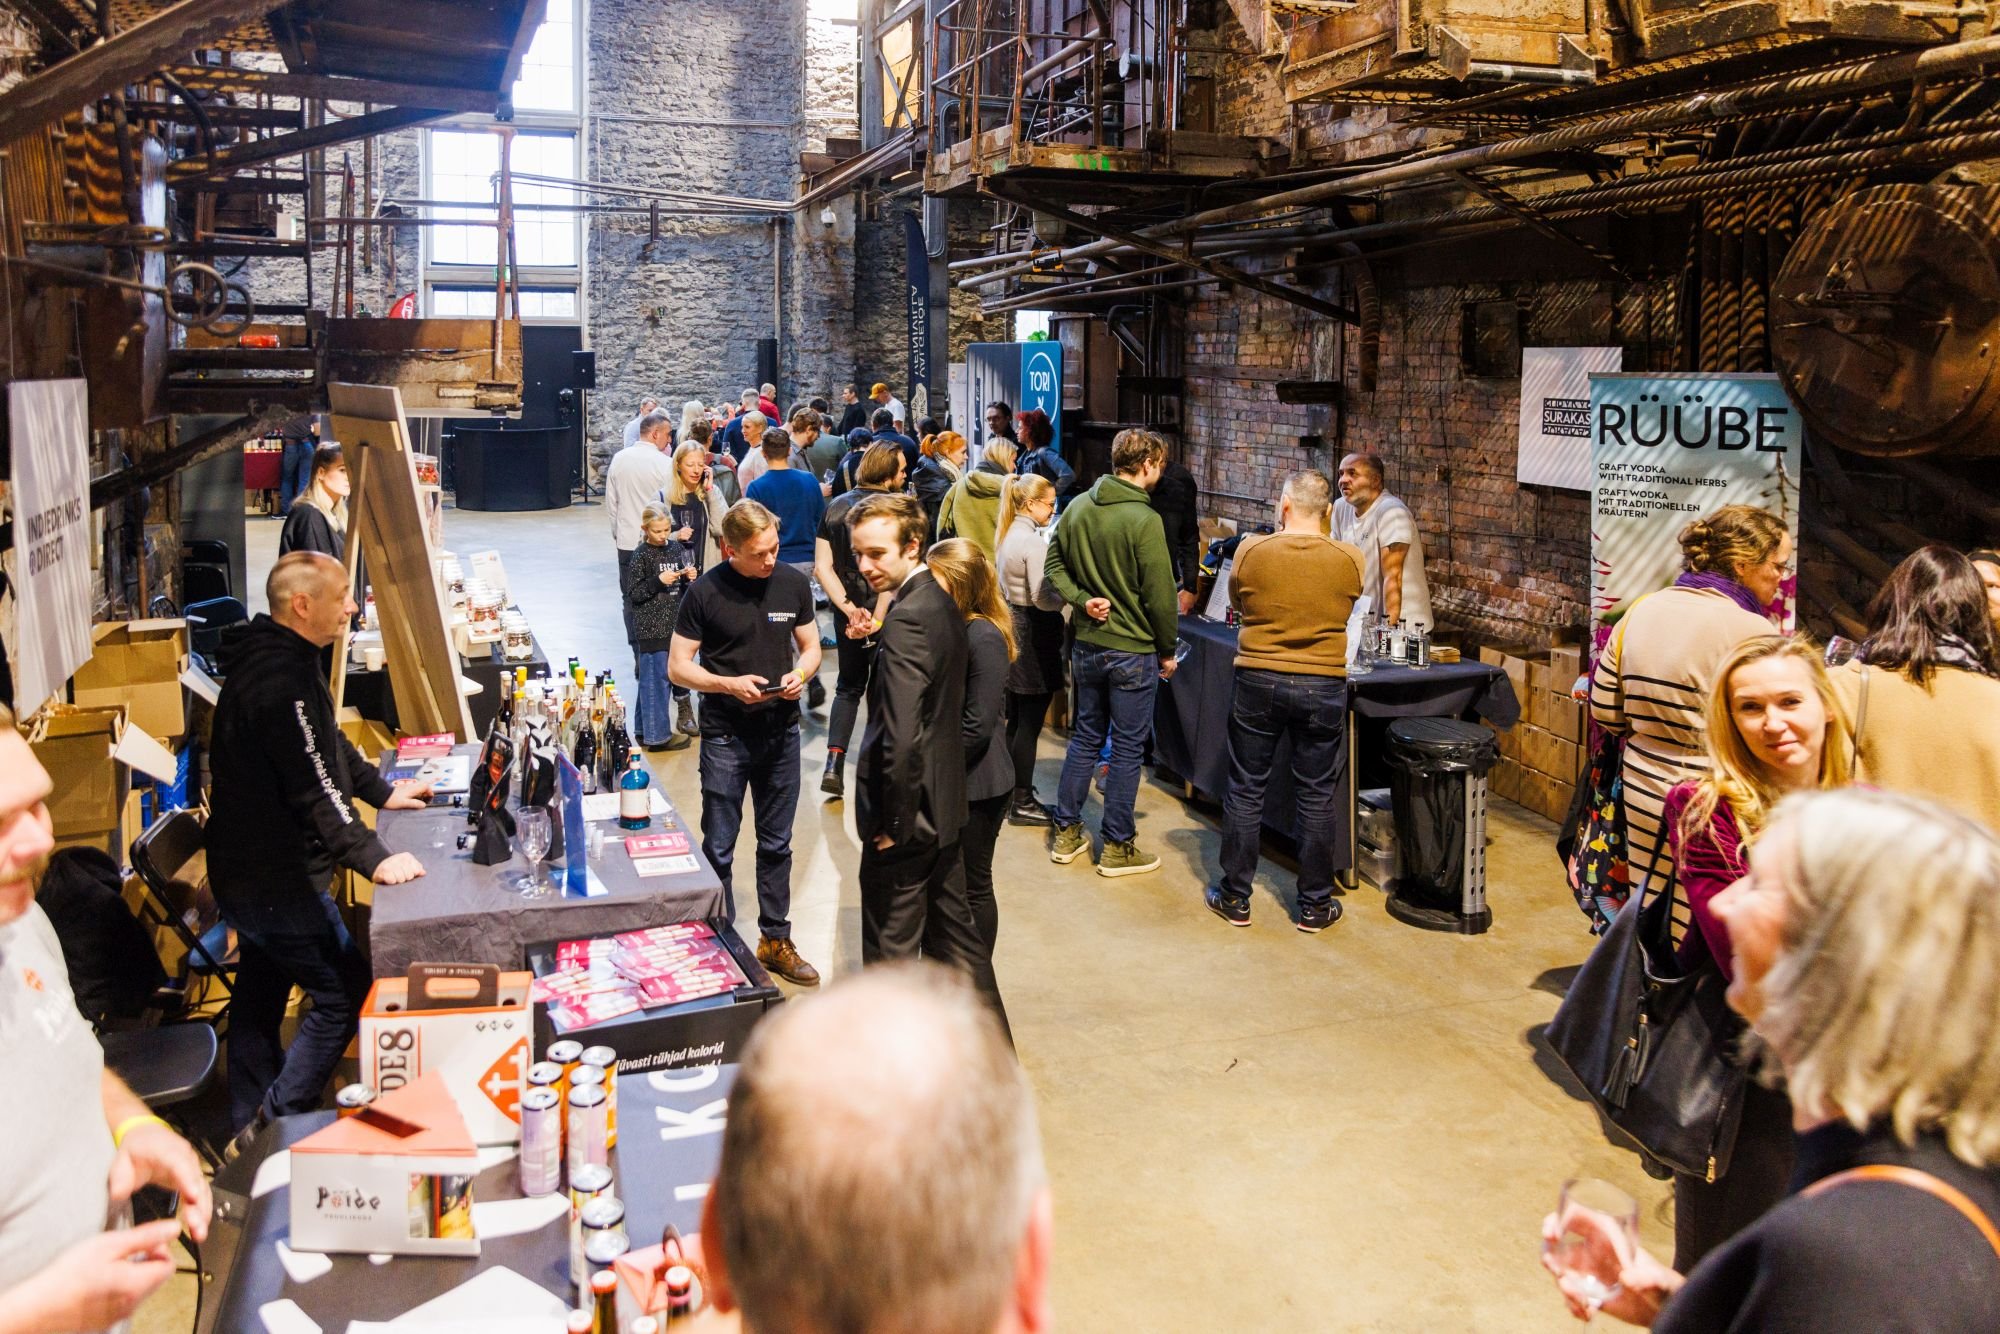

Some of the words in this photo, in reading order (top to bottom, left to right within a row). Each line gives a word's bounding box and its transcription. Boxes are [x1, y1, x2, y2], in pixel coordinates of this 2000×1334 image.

[1030, 371, 1050, 392] TORI
[1543, 410, 1592, 425] SURAKAS
[1599, 394, 1789, 453] RÜÜBE
[1598, 463, 1628, 472] CRAFT
[1630, 464, 1666, 474] VODKA
[1598, 472, 1624, 481] WITH
[1625, 474, 1694, 486] TRADITIONAL
[1695, 478, 1727, 488] HERBS
[1598, 488, 1628, 497] CRAFT
[1629, 490, 1669, 500] WODKA
[1598, 498, 1614, 506] MIT
[1616, 499, 1701, 512] TRADITIONELLEN
[1598, 507, 1649, 518] KRÄUTERN
[27, 497, 81, 544] INDIEDRINKS
[295, 700, 316, 753] Redefining
[310, 752, 328, 780] Drinks
[652, 1048, 687, 1066] tühjad
[687, 1040, 725, 1059] kalorid
[379, 1029, 414, 1097] DE8
